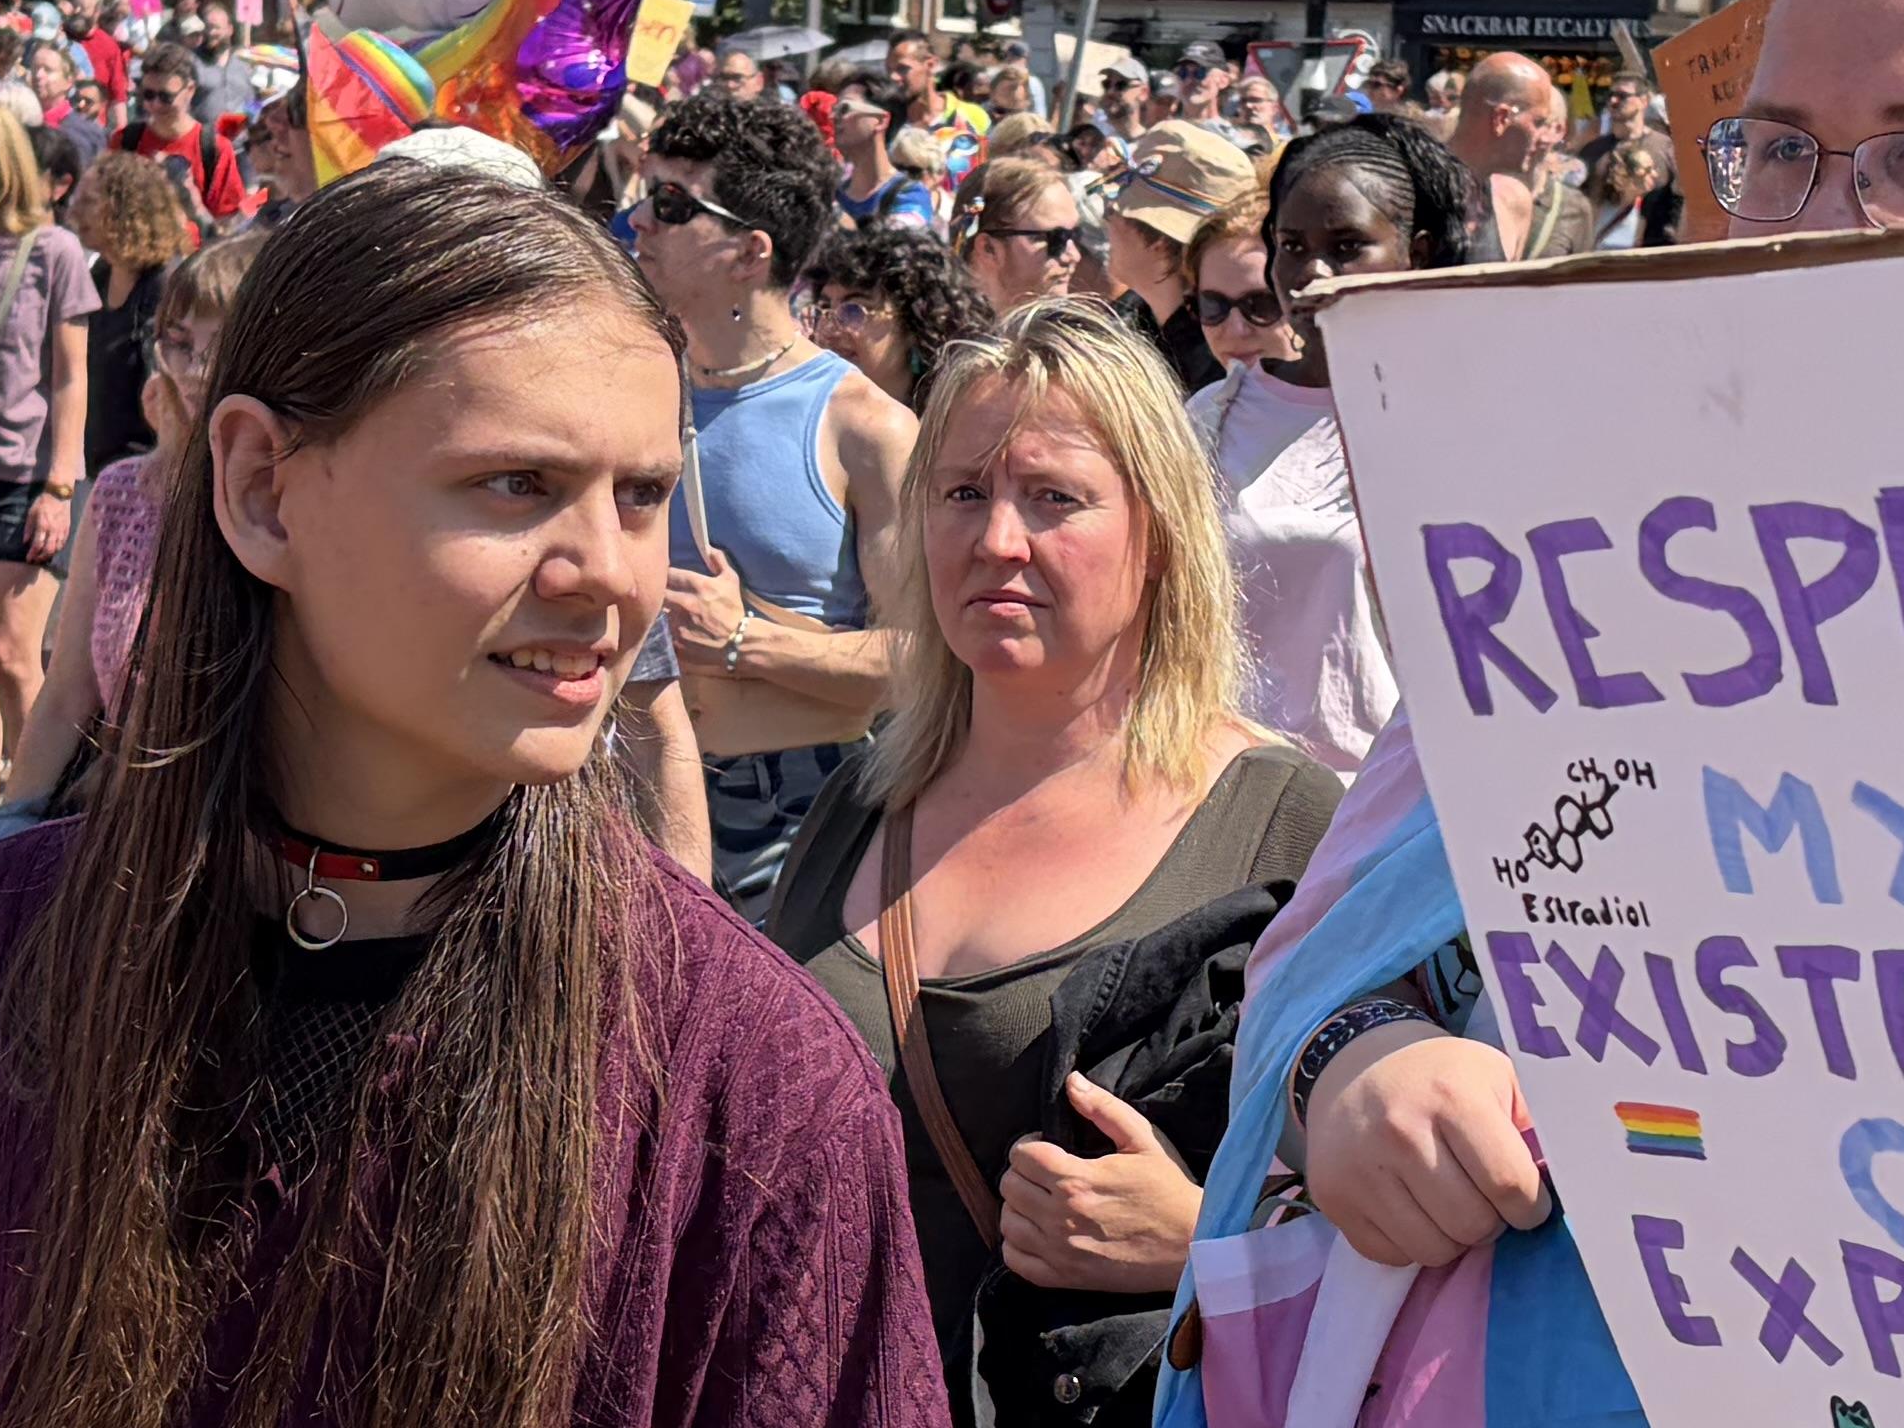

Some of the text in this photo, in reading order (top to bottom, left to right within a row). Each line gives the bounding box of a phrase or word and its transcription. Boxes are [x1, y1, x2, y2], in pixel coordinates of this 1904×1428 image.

[1422, 14, 1529, 37] SNACKBAR
[1614, 758, 1656, 790] OH
[1492, 856, 1530, 889] HO
[1521, 892, 1651, 927] Estradiol
